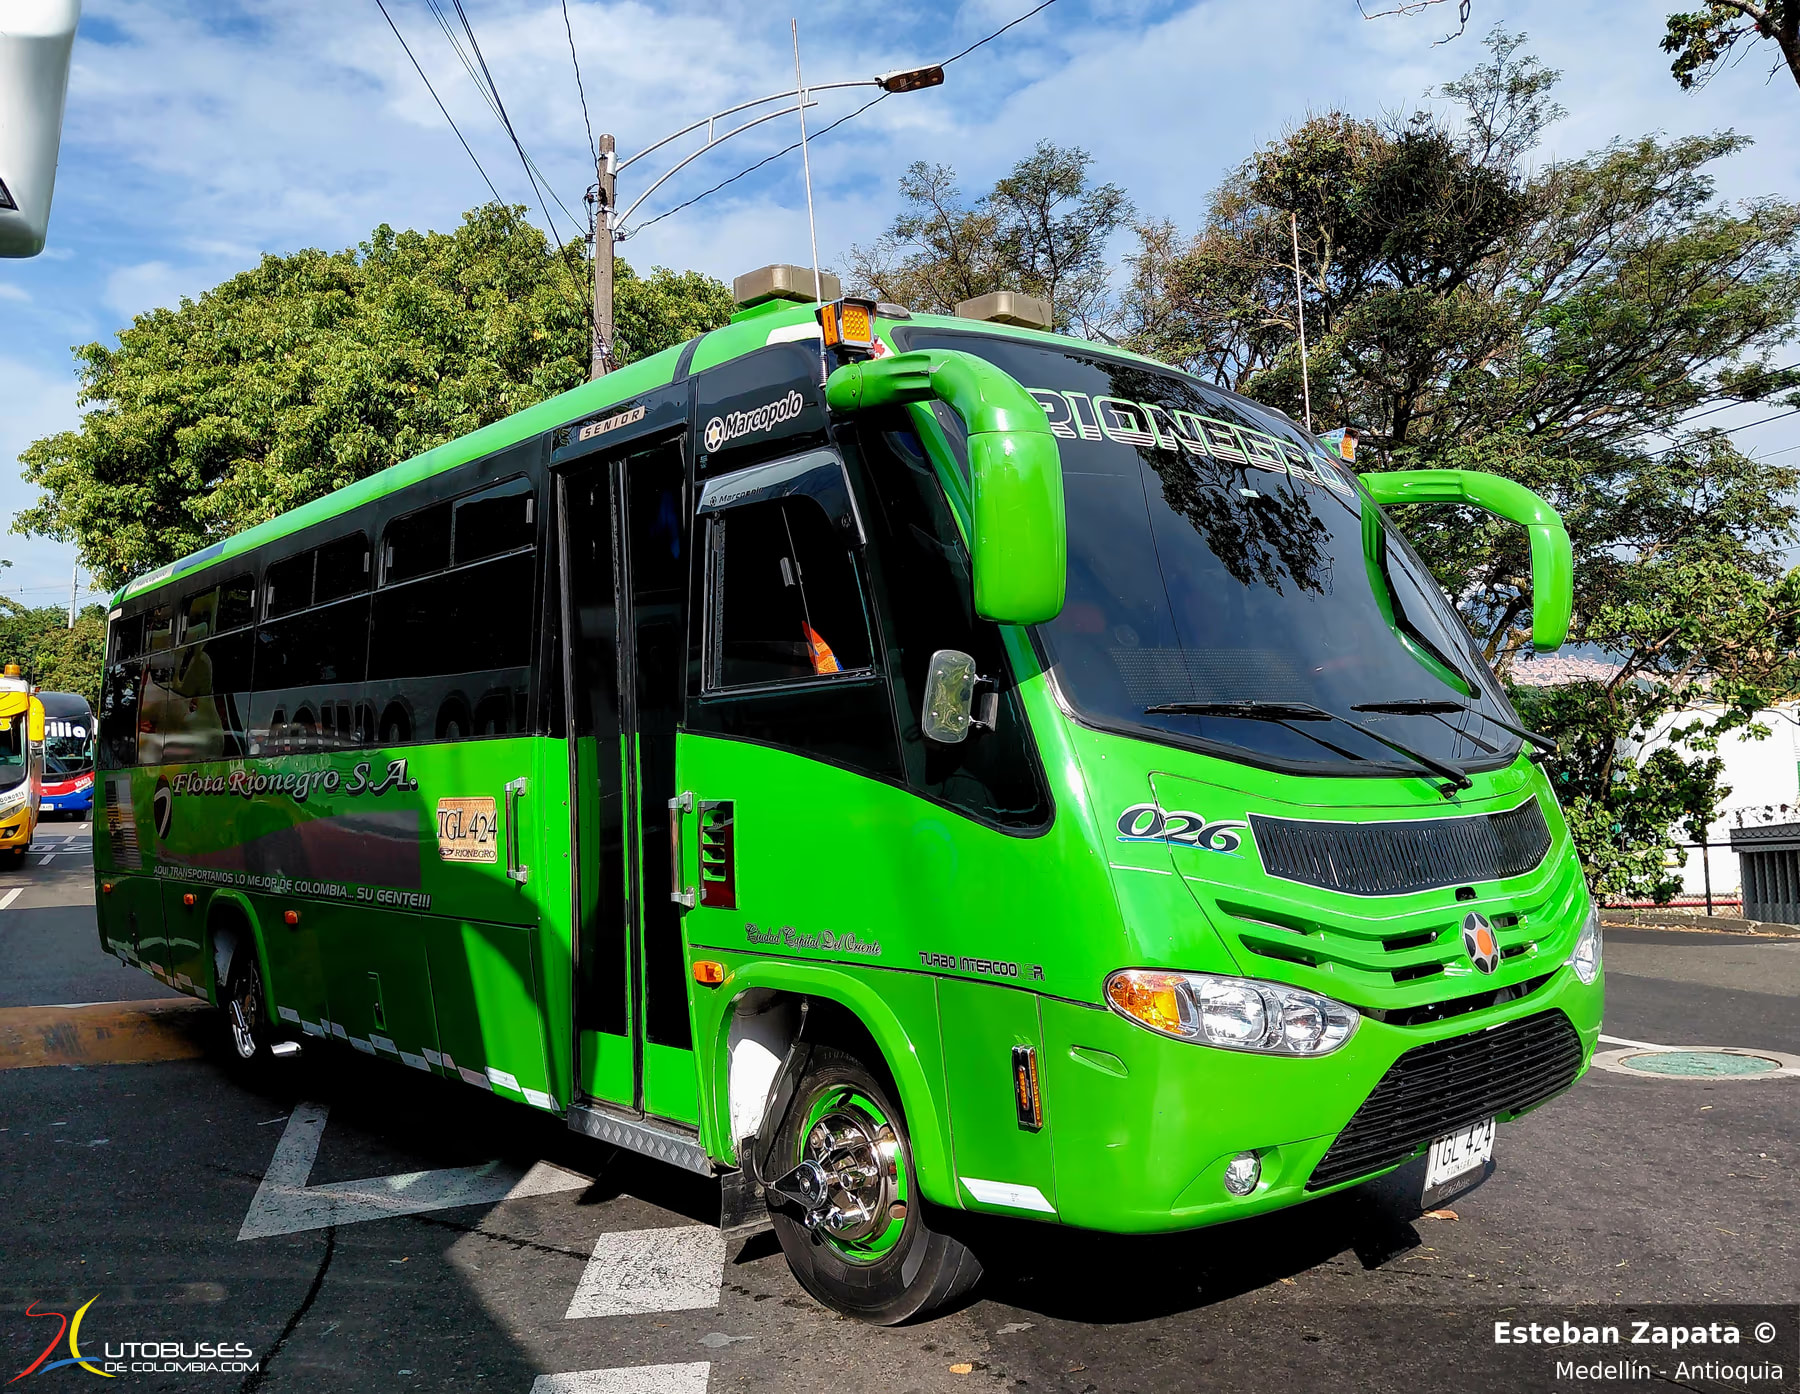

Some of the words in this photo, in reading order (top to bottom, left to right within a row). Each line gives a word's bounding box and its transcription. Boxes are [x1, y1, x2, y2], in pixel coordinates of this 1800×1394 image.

[584, 410, 640, 438] SENIOR
[723, 390, 803, 440] Marcopolo
[172, 769, 225, 795] Flota
[228, 768, 340, 801] Rionegro
[345, 758, 419, 797] S.A.
[436, 807, 467, 842] TGL
[469, 809, 498, 843] 424
[1116, 803, 1248, 852] 026
[455, 848, 496, 859] RIONEGRO
[153, 865, 170, 875] AQUI
[170, 866, 233, 884] TRANSPORTAMOS
[235, 873, 246, 885] LO
[247, 875, 277, 889] MEJOR
[279, 878, 293, 891] DE
[356, 887, 373, 901] SU
[376, 890, 431, 911] GENTE!!!
[745, 922, 781, 945] Ciudad
[782, 926, 822, 953] Capital
[821, 929, 845, 952] Del
[844, 931, 882, 957] Oriente
[918, 951, 957, 971] TURBO
[1433, 1132, 1459, 1171] TGL
[1465, 1117, 1493, 1157] 424
